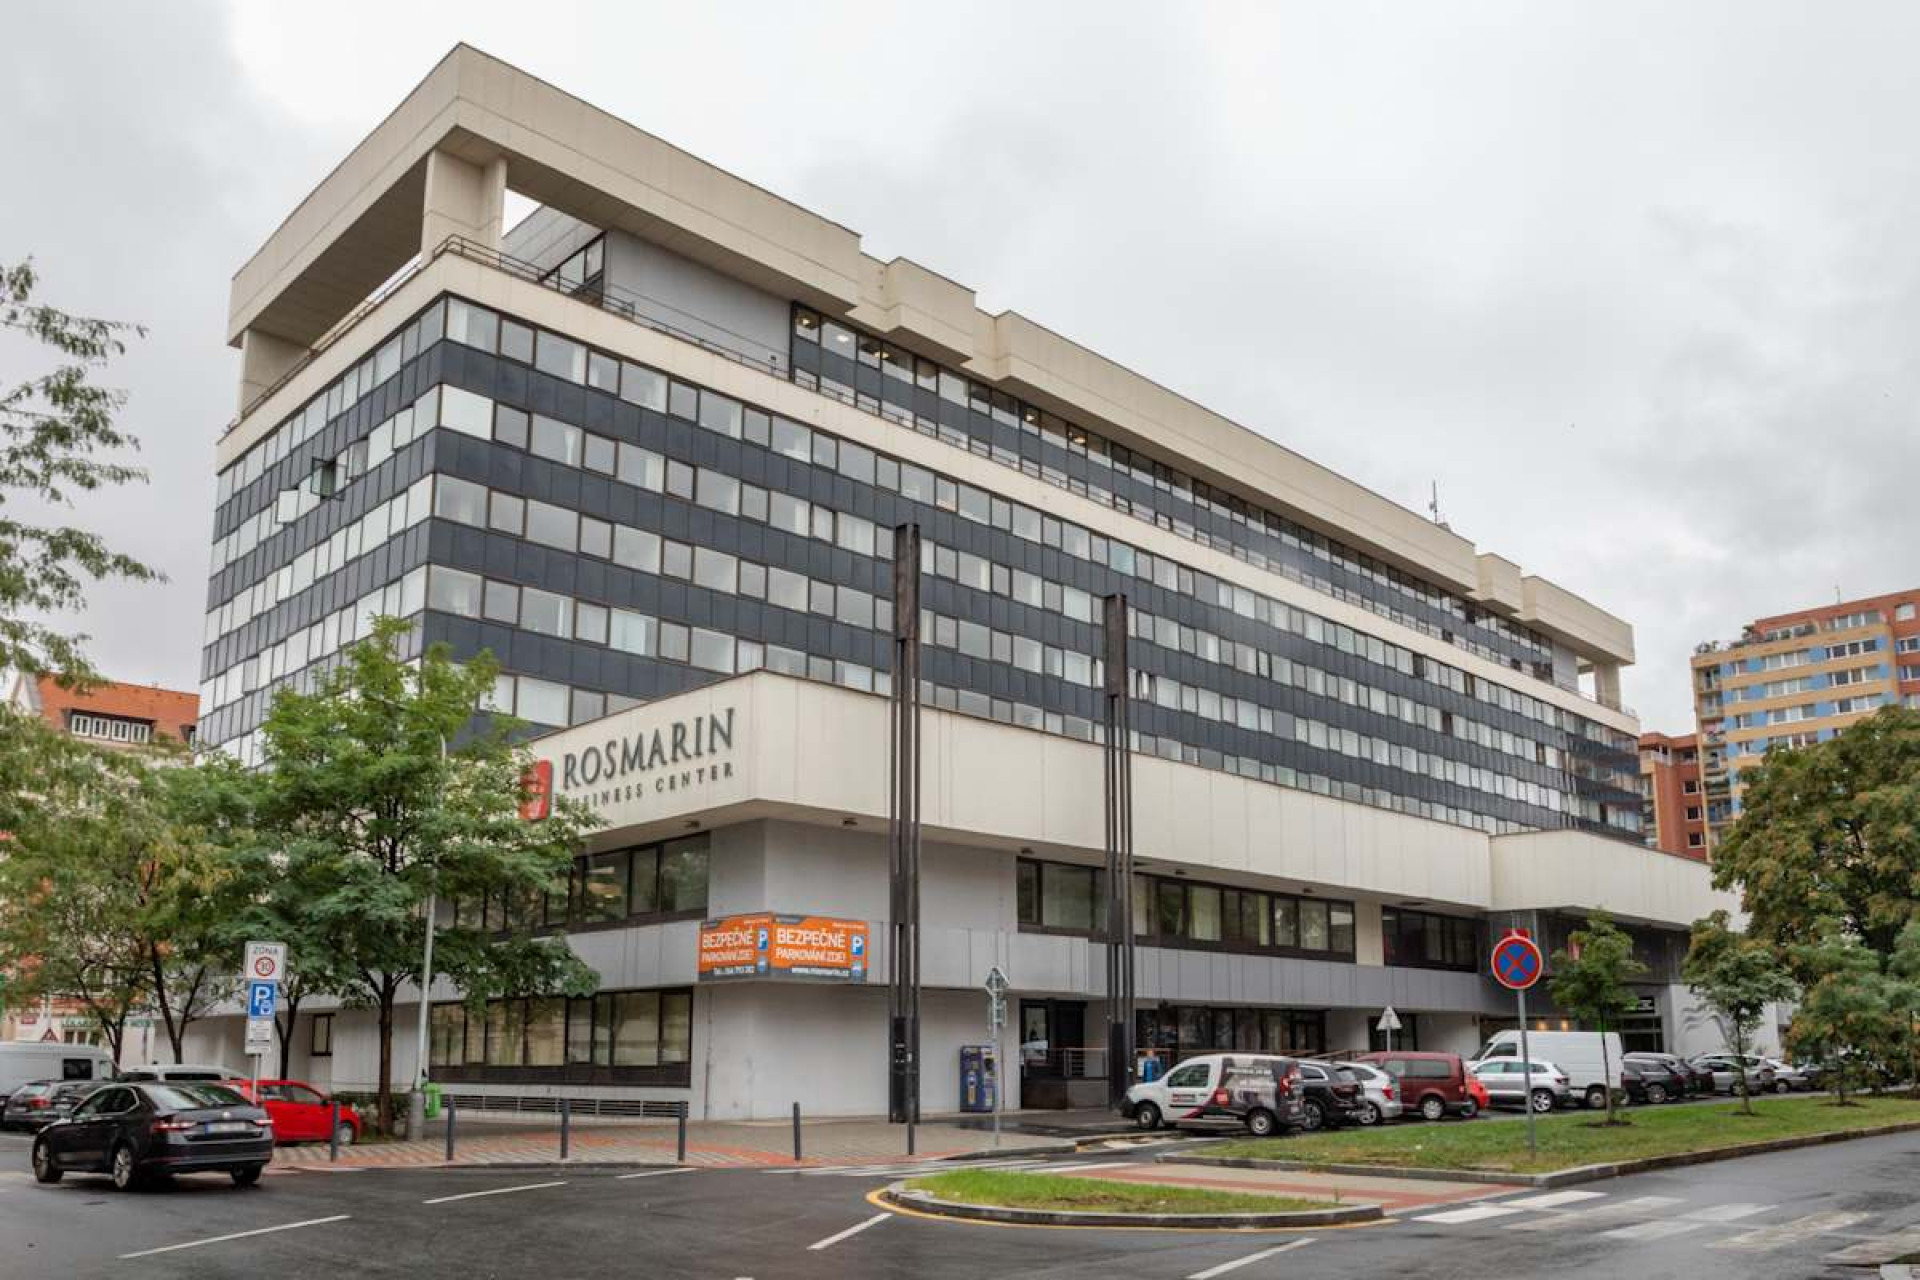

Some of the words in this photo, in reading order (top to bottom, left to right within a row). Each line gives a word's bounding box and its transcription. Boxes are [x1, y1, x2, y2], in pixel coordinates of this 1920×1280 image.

[563, 708, 735, 790] ROSMARIN
[655, 762, 733, 793] CENTER
[777, 928, 846, 948] BEZPEČNÉ
